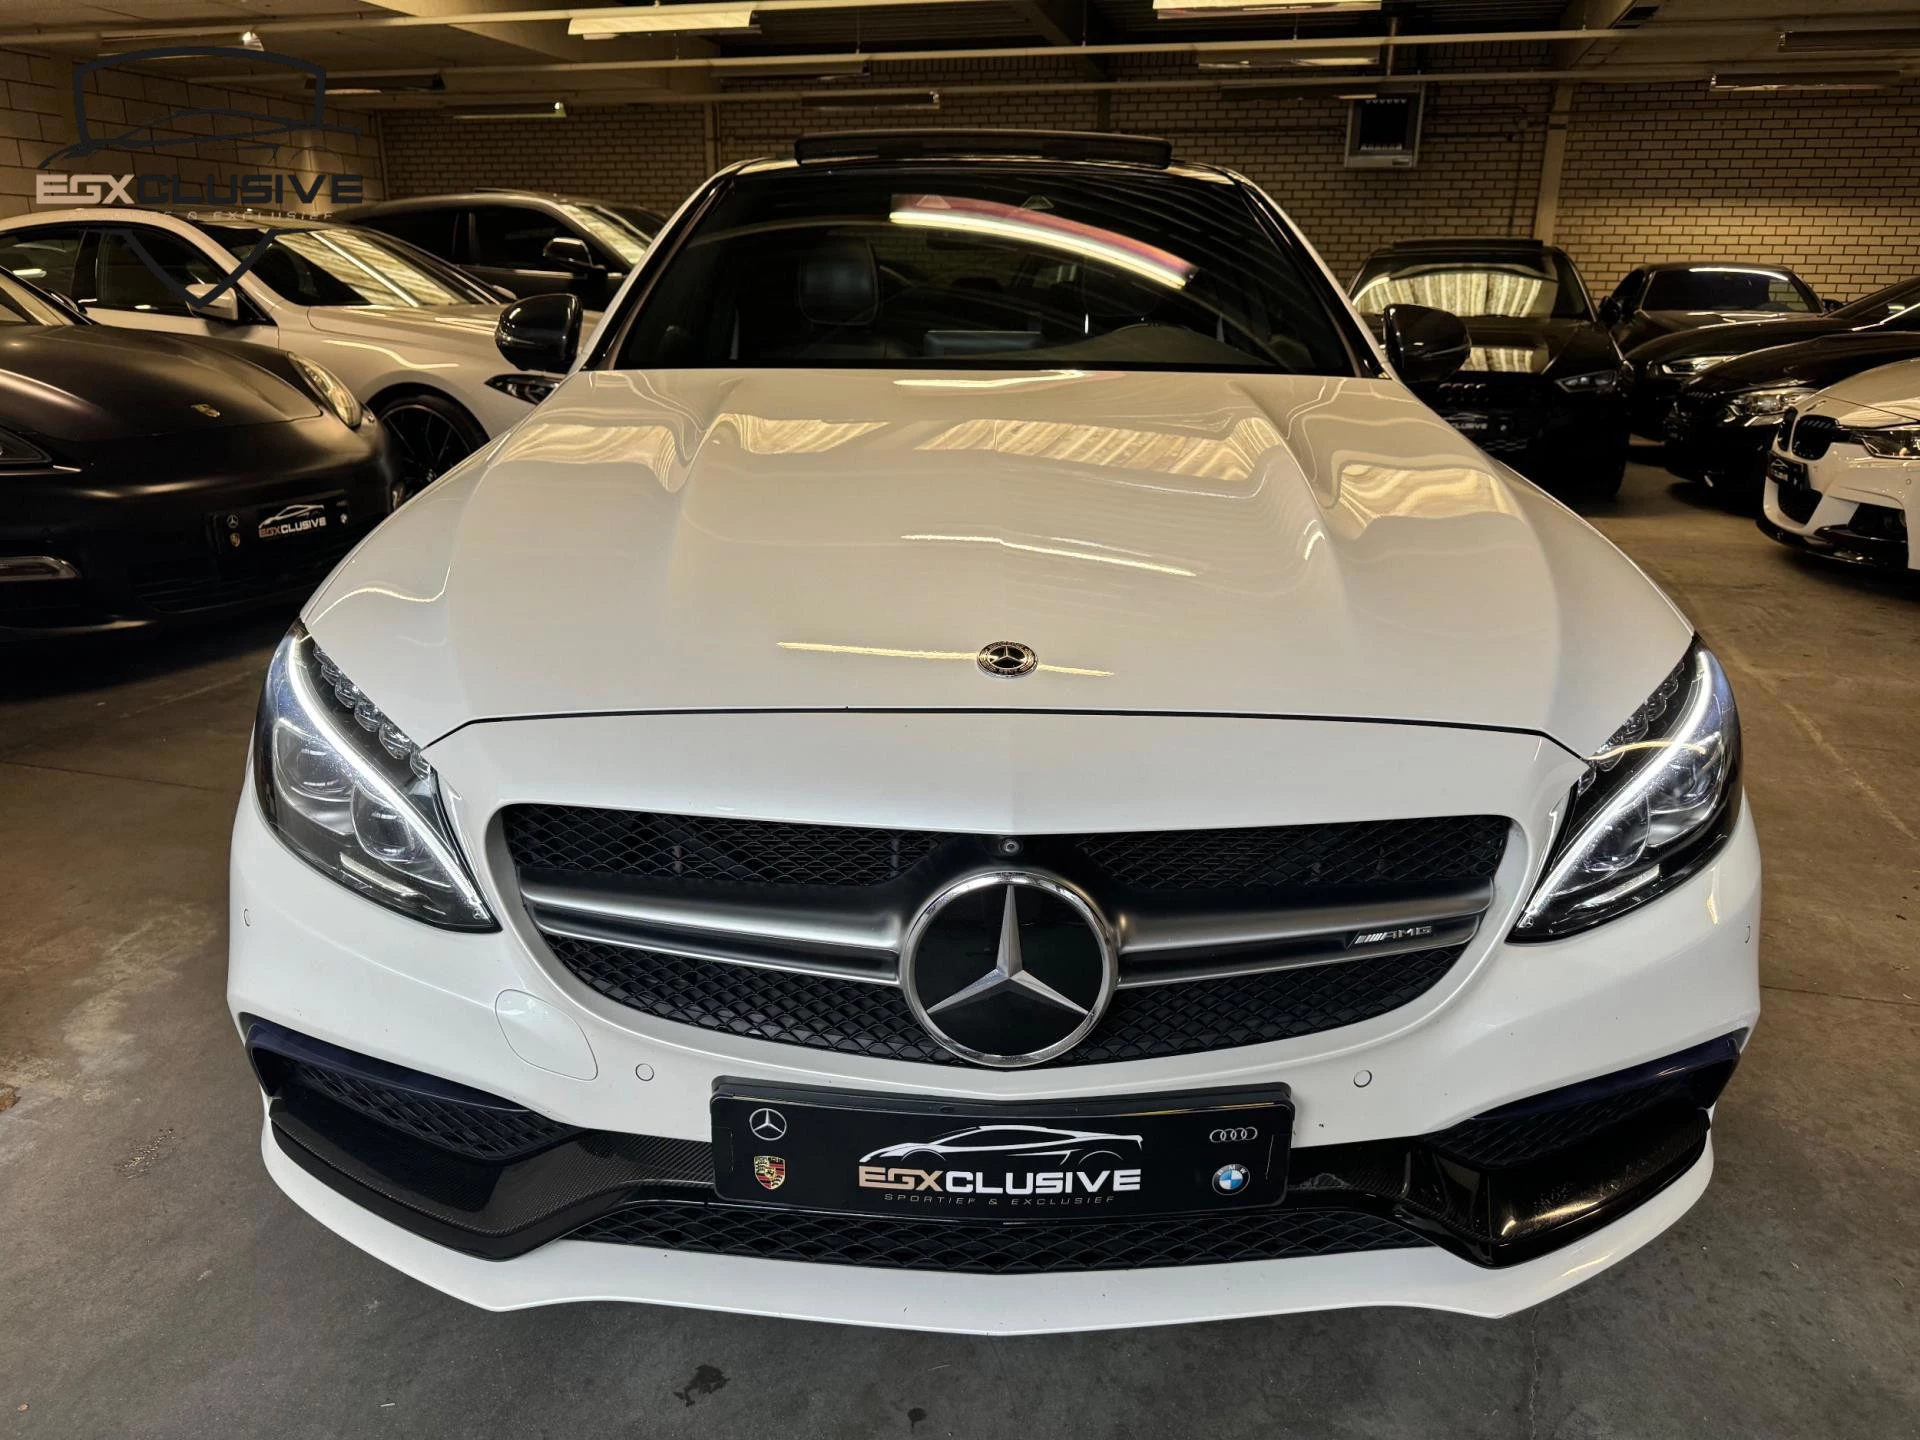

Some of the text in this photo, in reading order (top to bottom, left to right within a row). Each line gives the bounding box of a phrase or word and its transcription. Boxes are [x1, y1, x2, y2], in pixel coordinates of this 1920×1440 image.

[1384, 925, 1432, 939] AMG
[859, 1165, 1141, 1195] EGXCLUSIVE
[884, 1193, 1115, 1206] SPORTIEF & EXCLUSIEF
